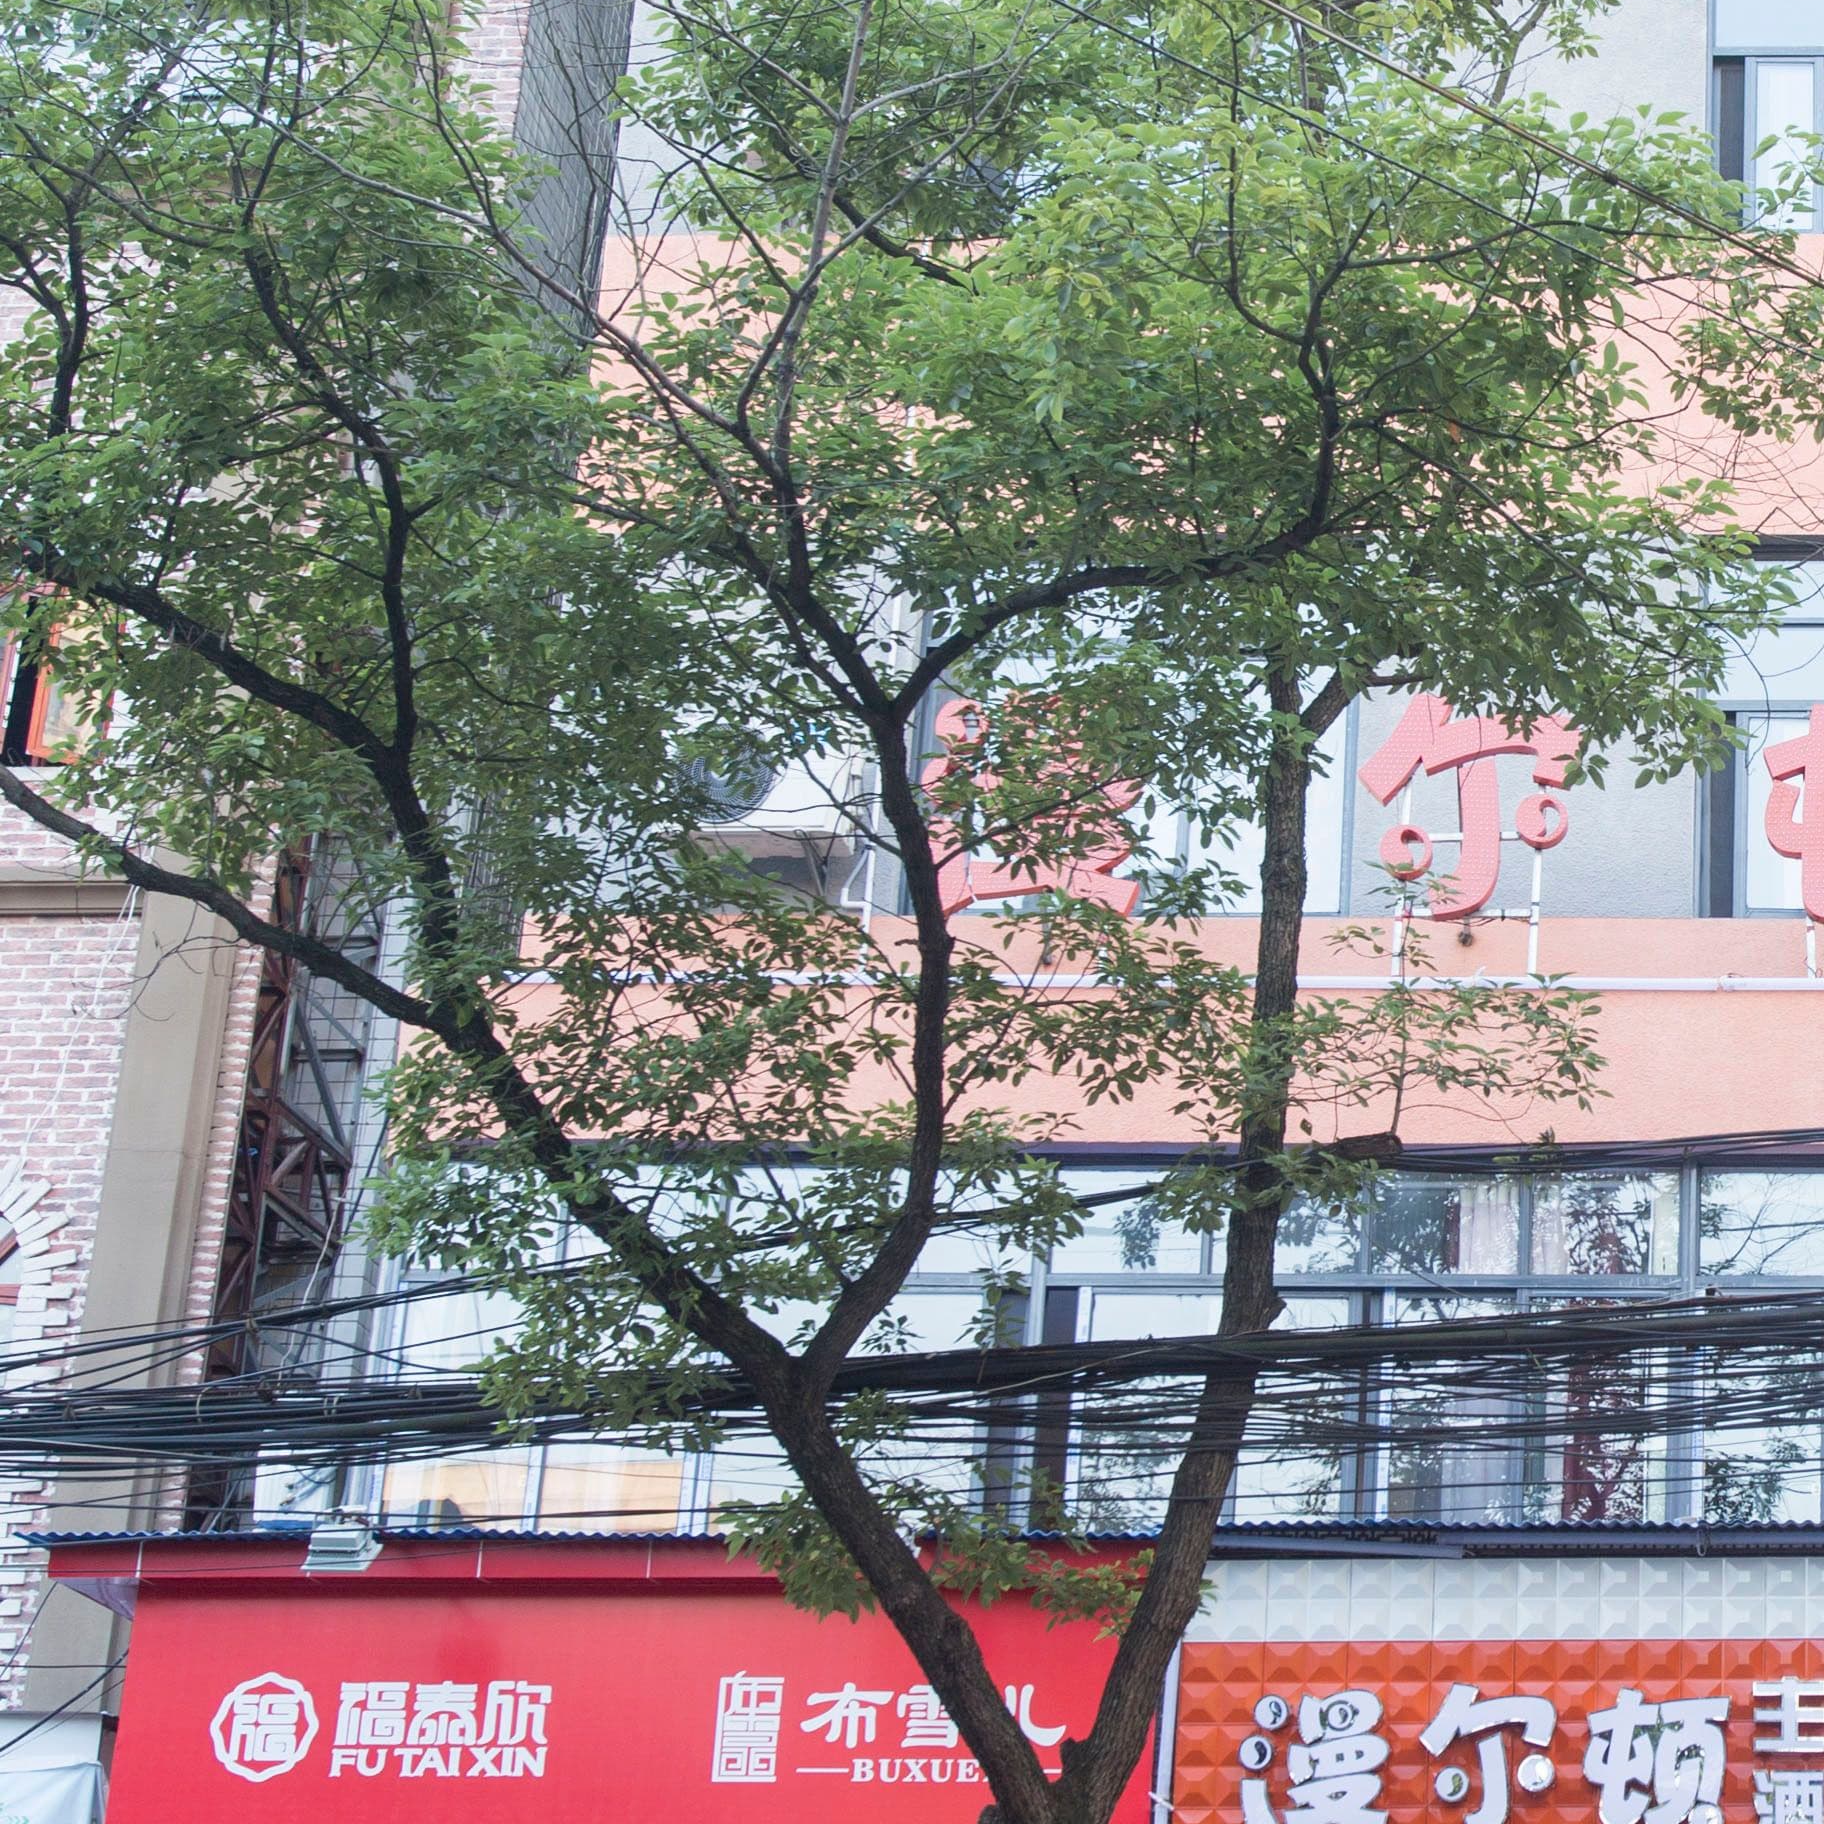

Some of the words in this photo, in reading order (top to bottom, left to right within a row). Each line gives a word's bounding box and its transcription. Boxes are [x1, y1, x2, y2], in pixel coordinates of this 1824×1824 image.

[333, 1680, 552, 1746] 福泰欣
[851, 1758, 990, 1784] BUXUE
